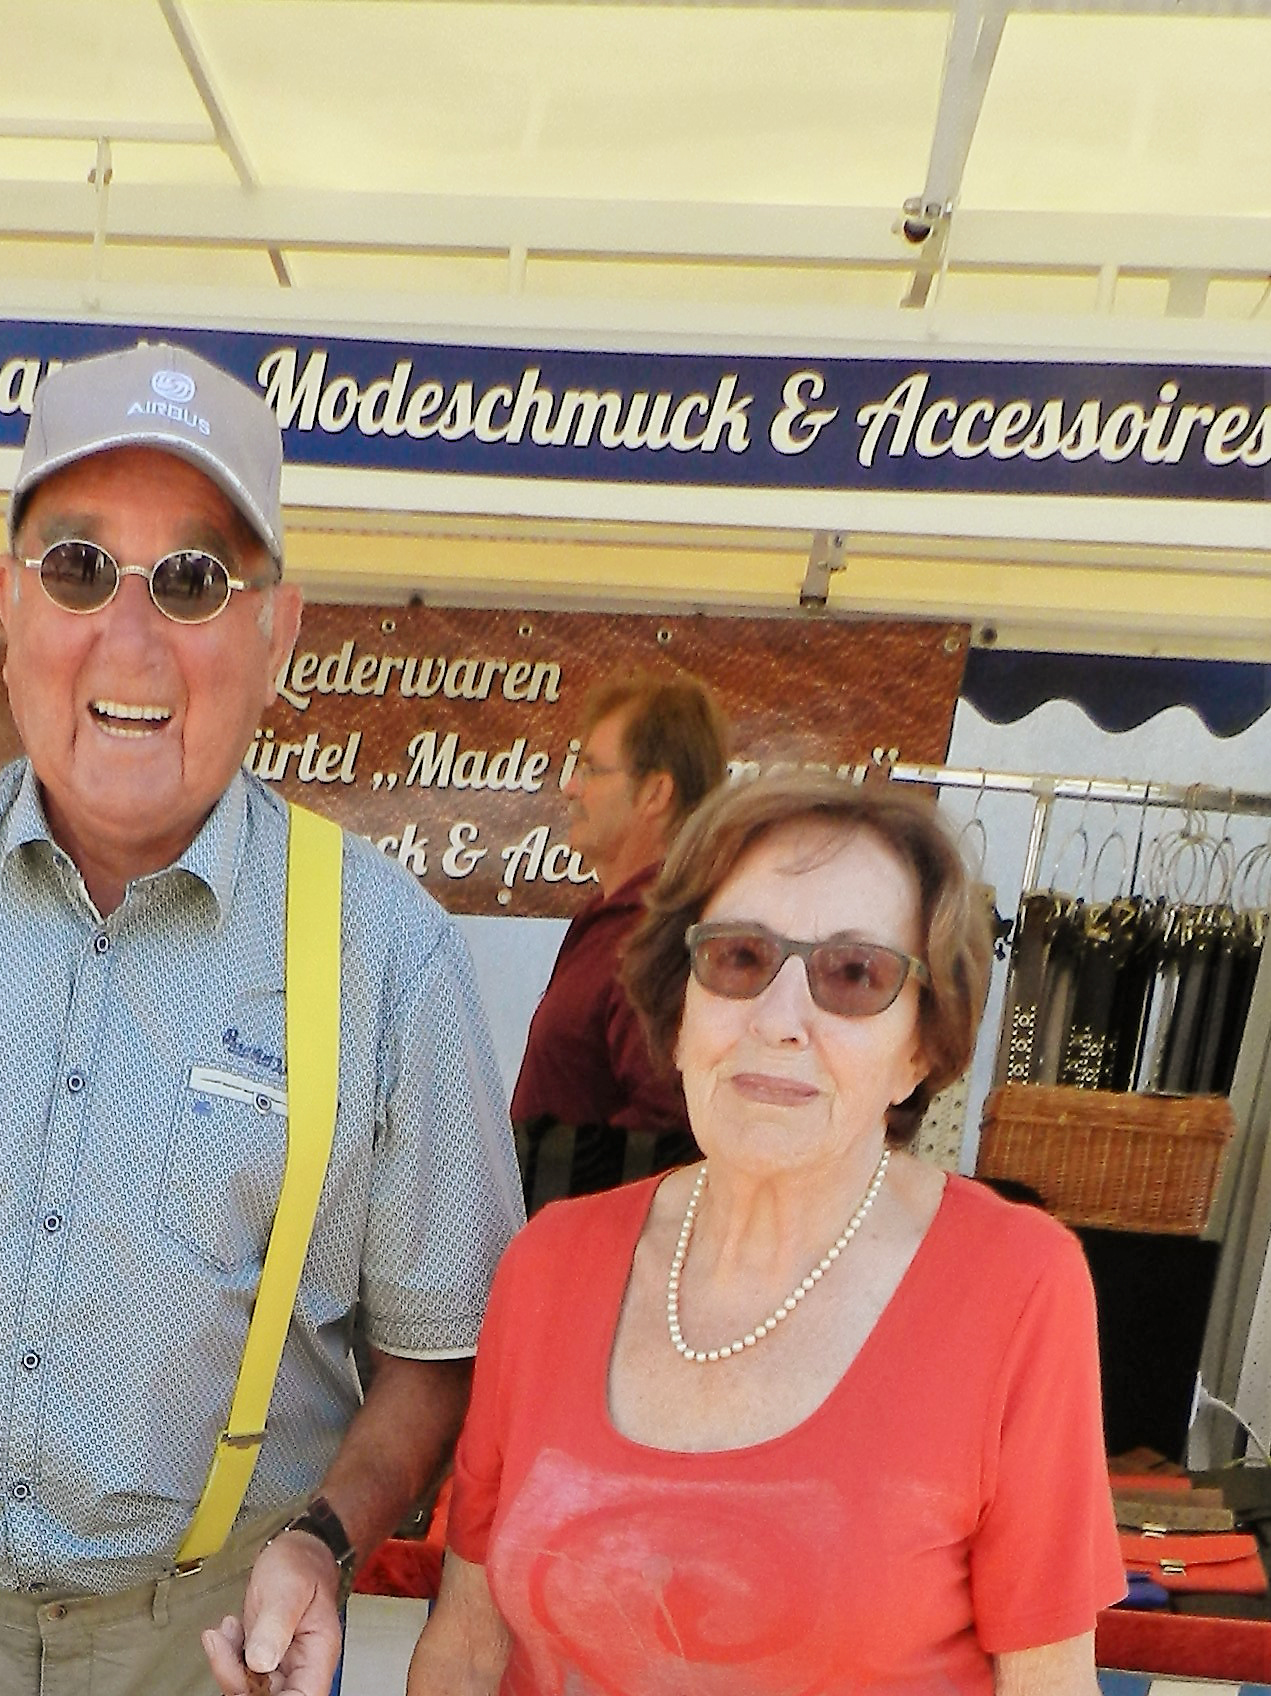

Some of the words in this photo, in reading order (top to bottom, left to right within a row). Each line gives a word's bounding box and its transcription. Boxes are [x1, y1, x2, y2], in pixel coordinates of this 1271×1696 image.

[127, 402, 211, 436] AIRBUS
[256, 348, 751, 456] Modeschmuck
[770, 371, 838, 456] &
[442, 822, 489, 879] &
